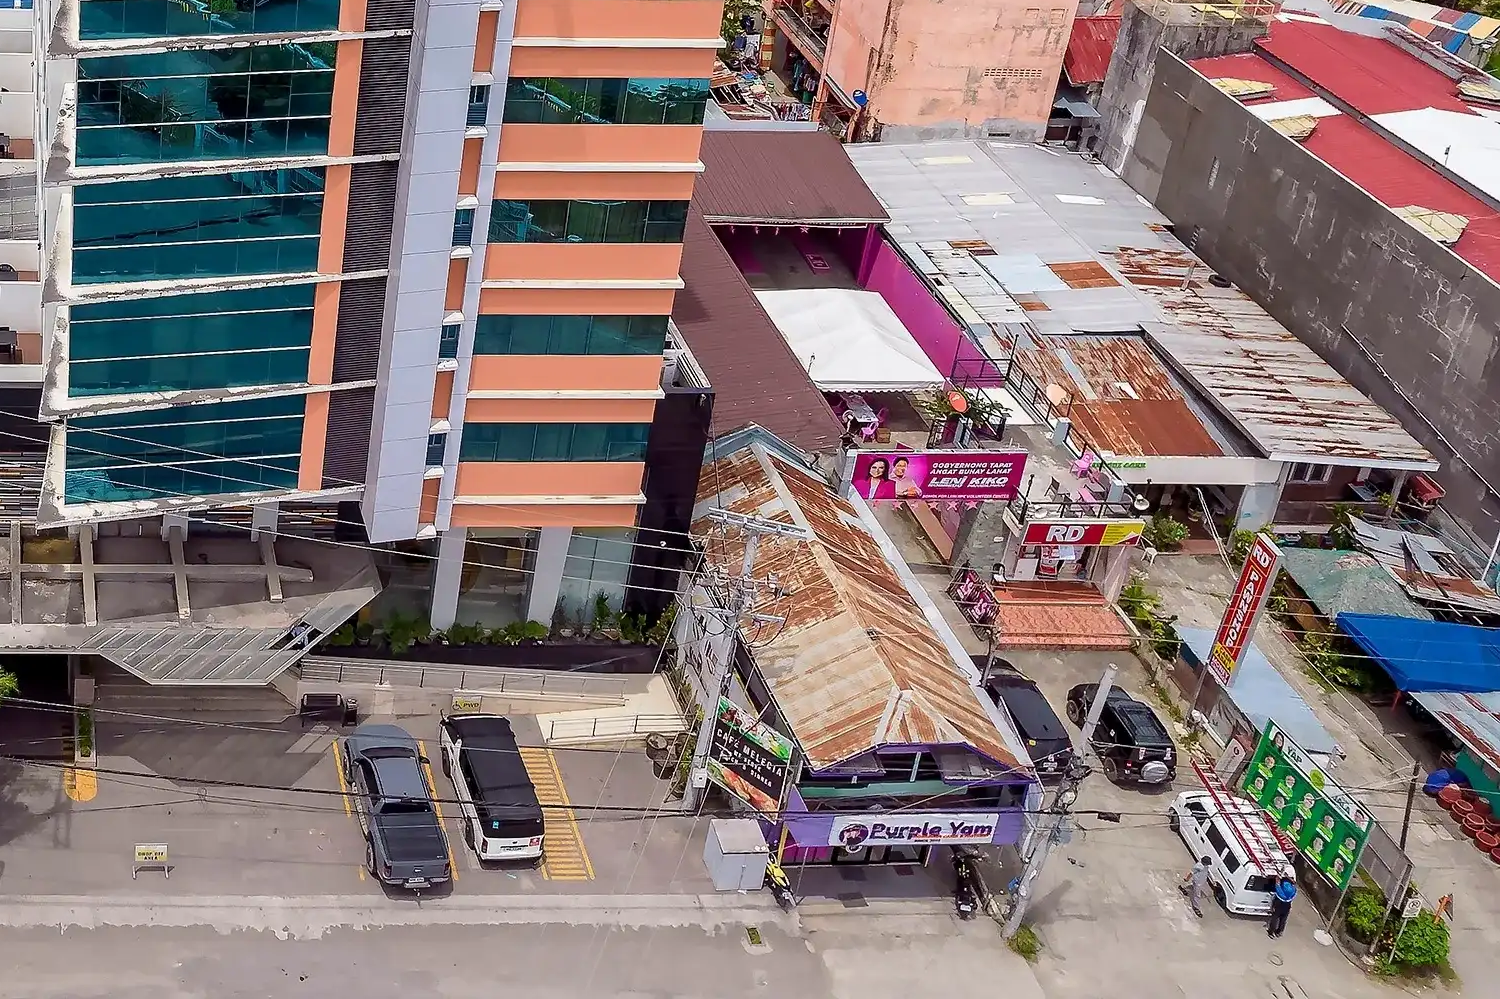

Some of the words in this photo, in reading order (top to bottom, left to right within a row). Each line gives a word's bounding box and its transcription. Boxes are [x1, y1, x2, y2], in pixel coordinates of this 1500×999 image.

[969, 476, 1009, 486] KIKO
[1045, 525, 1085, 542] RD
[1252, 543, 1270, 568] RD
[1225, 570, 1259, 648] PAWNSHOP
[743, 744, 782, 777] MELECIA
[1287, 746, 1303, 764] YAP
[869, 821, 942, 840] Purple
[949, 821, 993, 836] Yam
